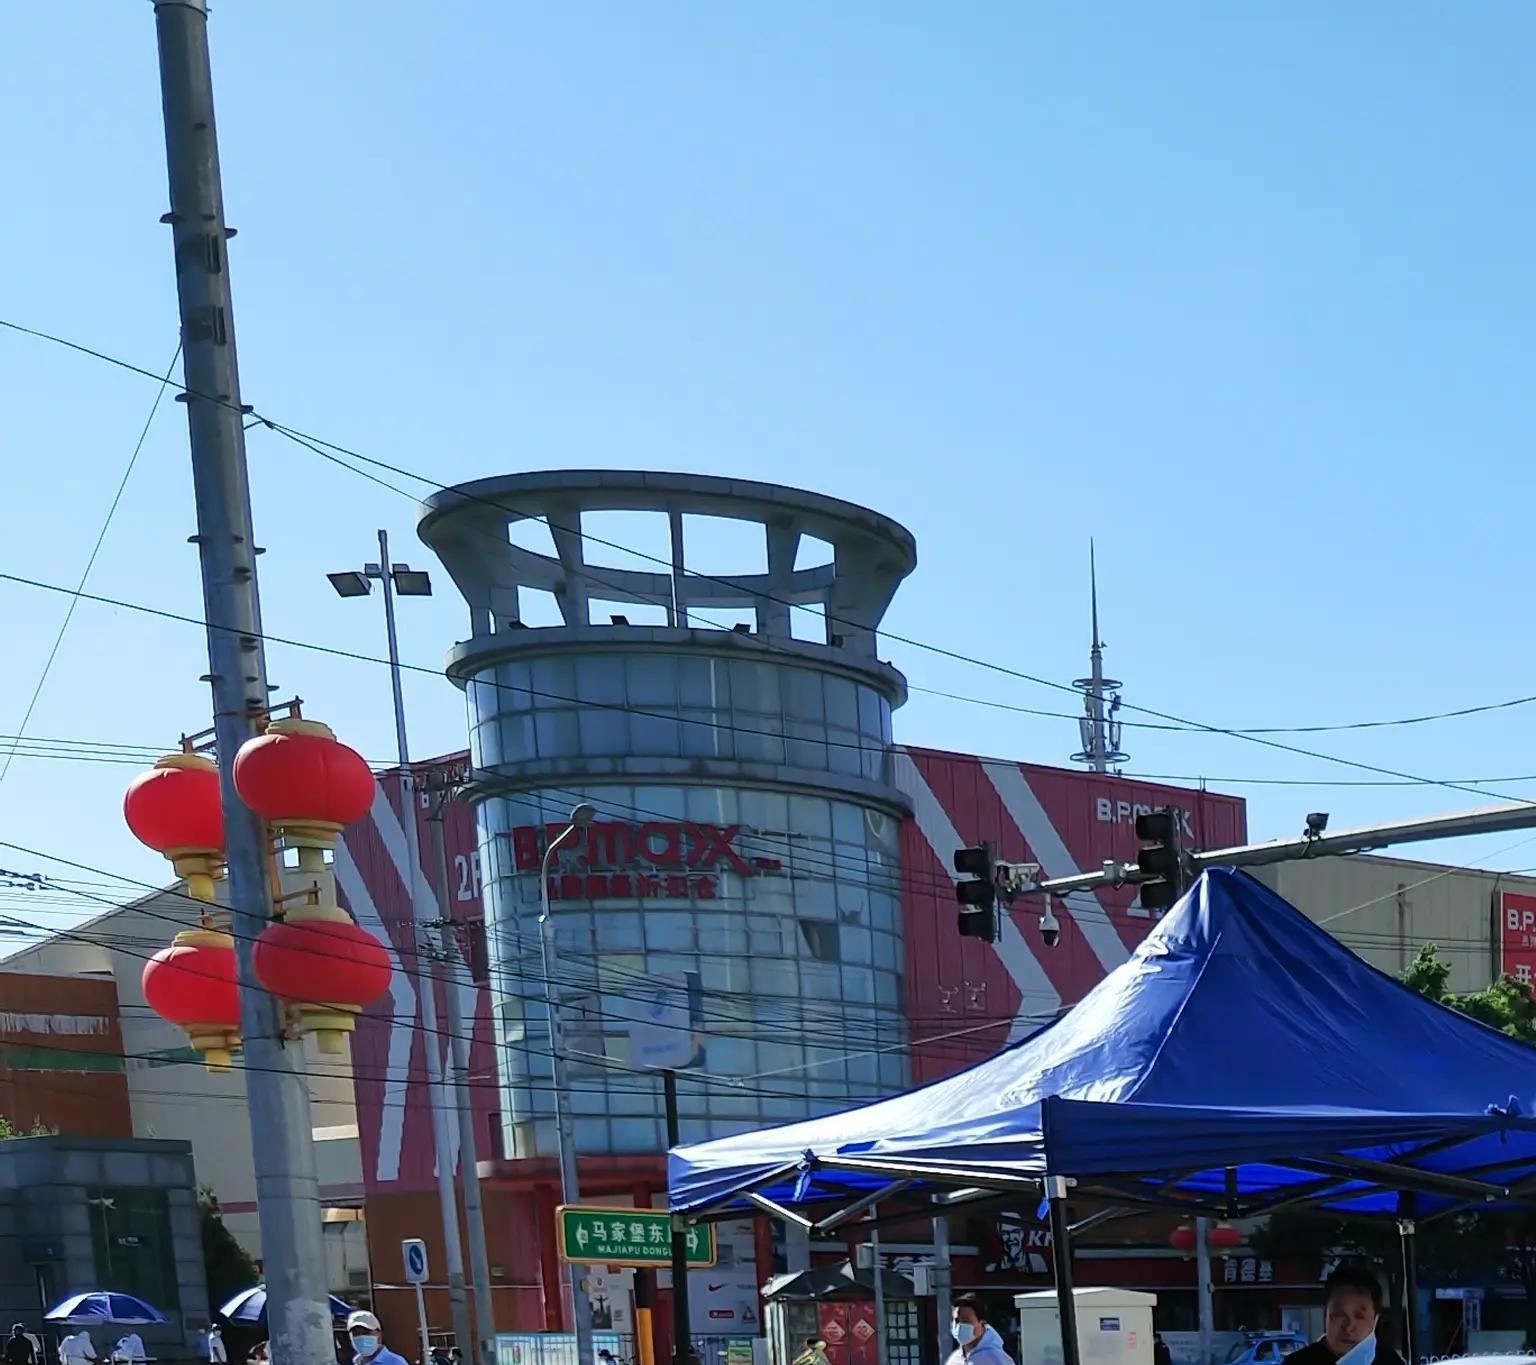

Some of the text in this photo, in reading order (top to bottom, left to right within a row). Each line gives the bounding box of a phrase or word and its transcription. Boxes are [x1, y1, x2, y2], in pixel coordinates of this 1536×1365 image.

[592, 1221, 673, 1243] 马家堡东
[1028, 1230, 1053, 1247] KF
